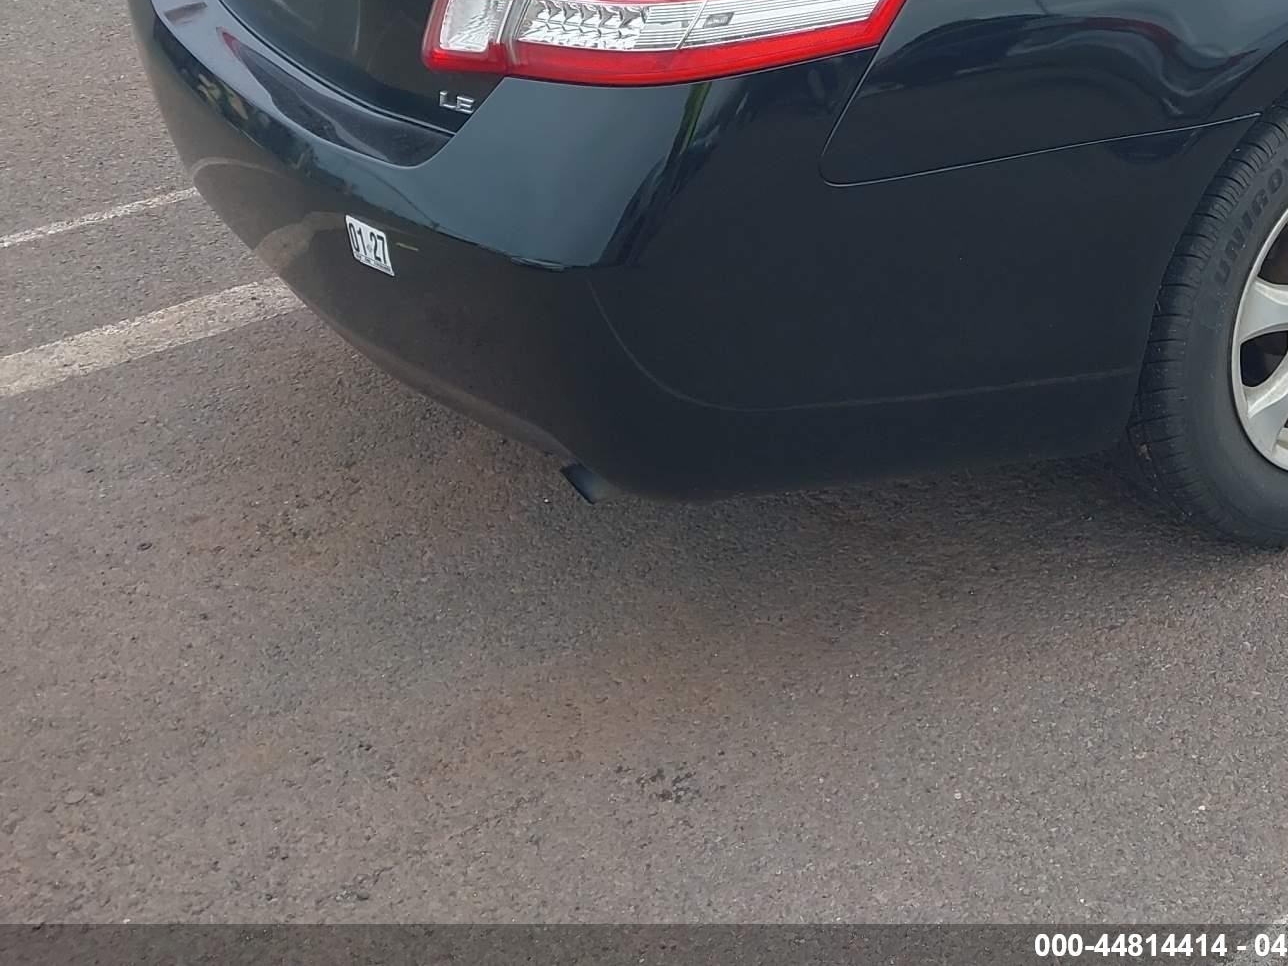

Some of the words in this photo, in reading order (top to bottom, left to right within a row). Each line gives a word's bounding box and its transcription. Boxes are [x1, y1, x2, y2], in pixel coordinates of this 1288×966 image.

[439, 91, 475, 114] LE
[348, 222, 367, 256] 01
[369, 231, 388, 265] 27
